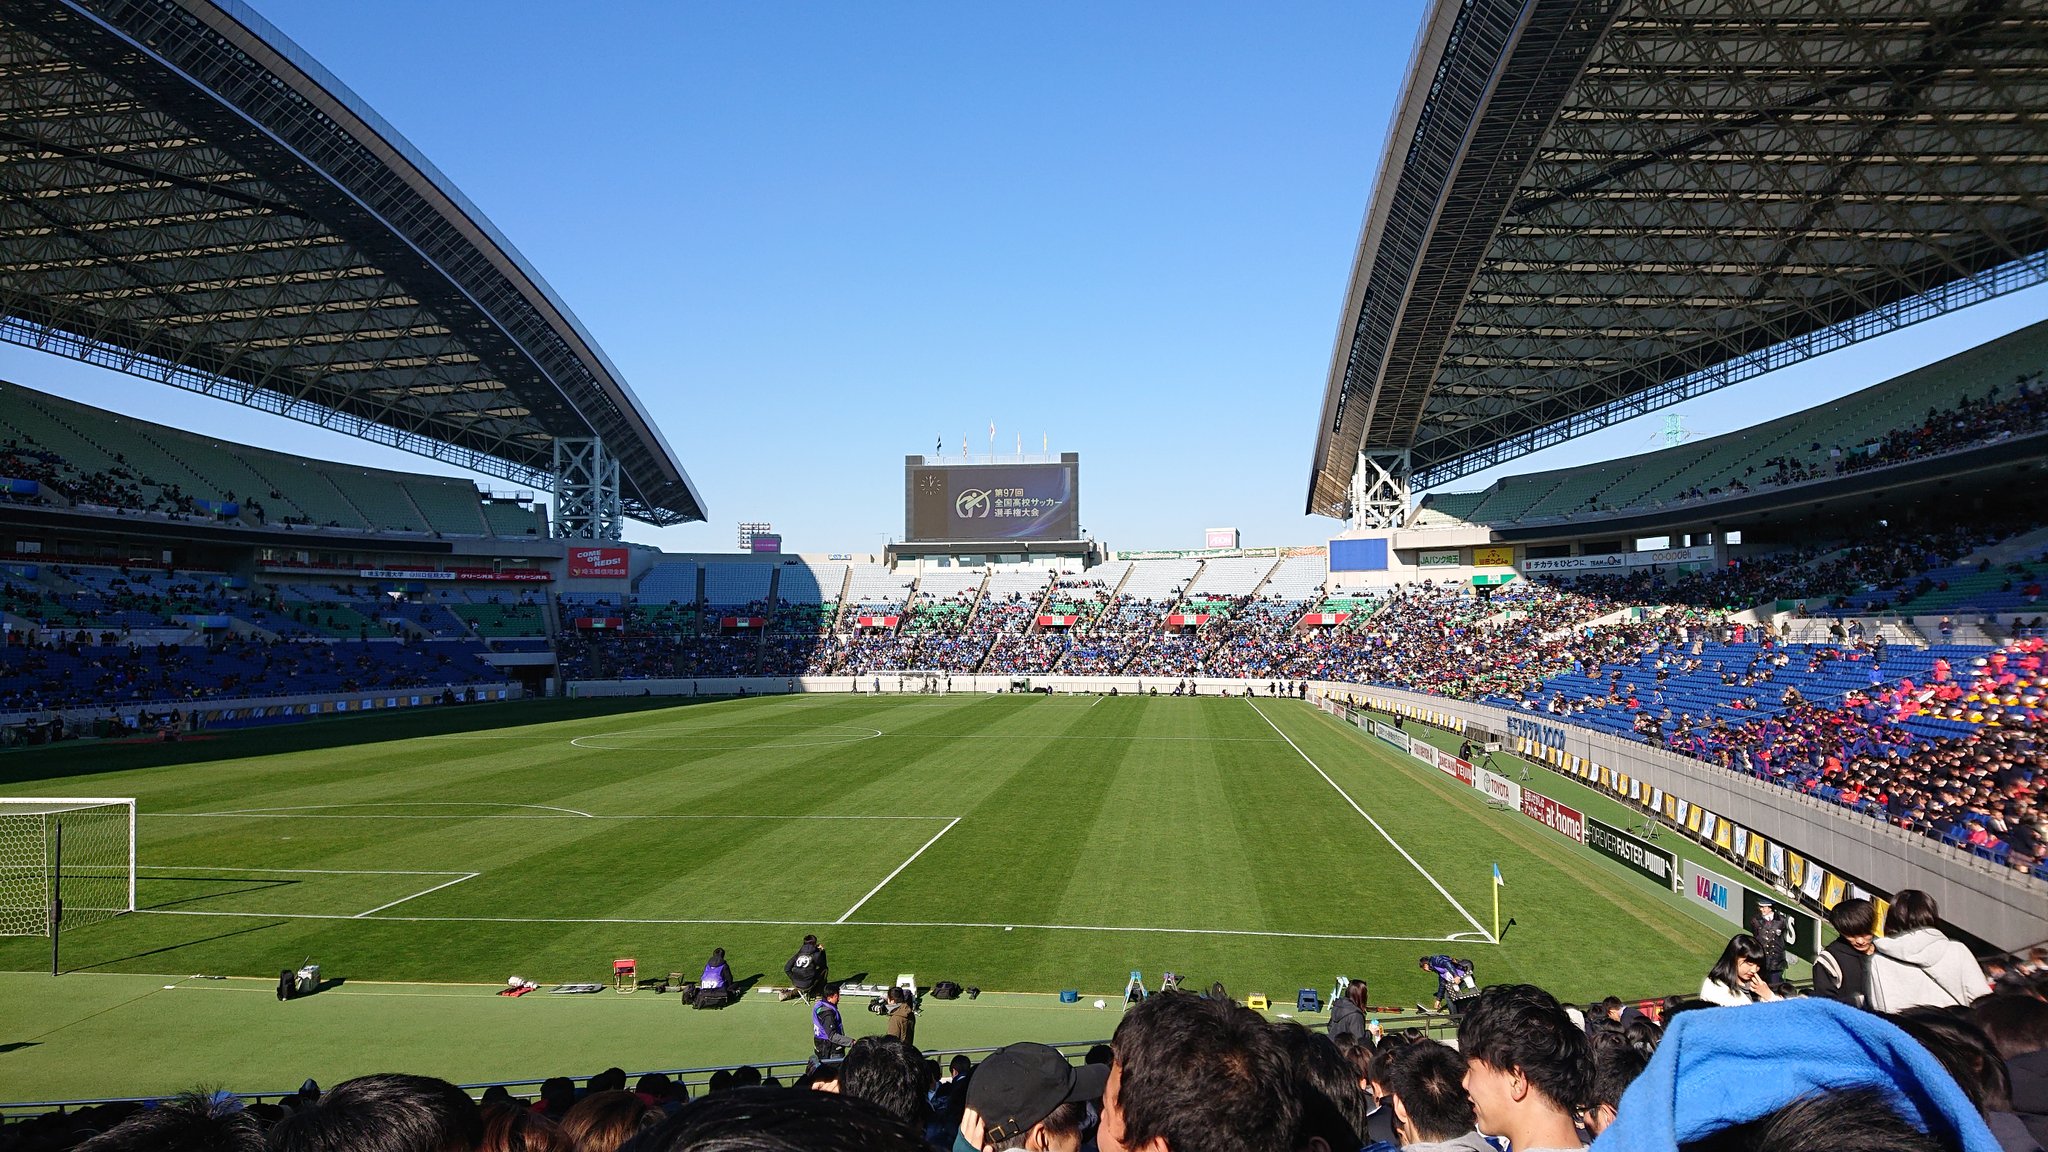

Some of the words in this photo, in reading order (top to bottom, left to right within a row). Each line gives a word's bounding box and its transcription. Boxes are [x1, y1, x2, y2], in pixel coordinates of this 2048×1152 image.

[995, 488, 1024, 497] 第97回
[995, 498, 1063, 508] 全国高校サッカー
[995, 508, 1040, 517] 選手権大会
[576, 550, 601, 558] COME
[594, 557, 621, 567] REDS!
[1420, 554, 1459, 565] JAバンク埼玉
[1490, 779, 1510, 801] TOYOTA
[1645, 850, 1667, 878] PUMA
[1696, 874, 1728, 911] VAAM
